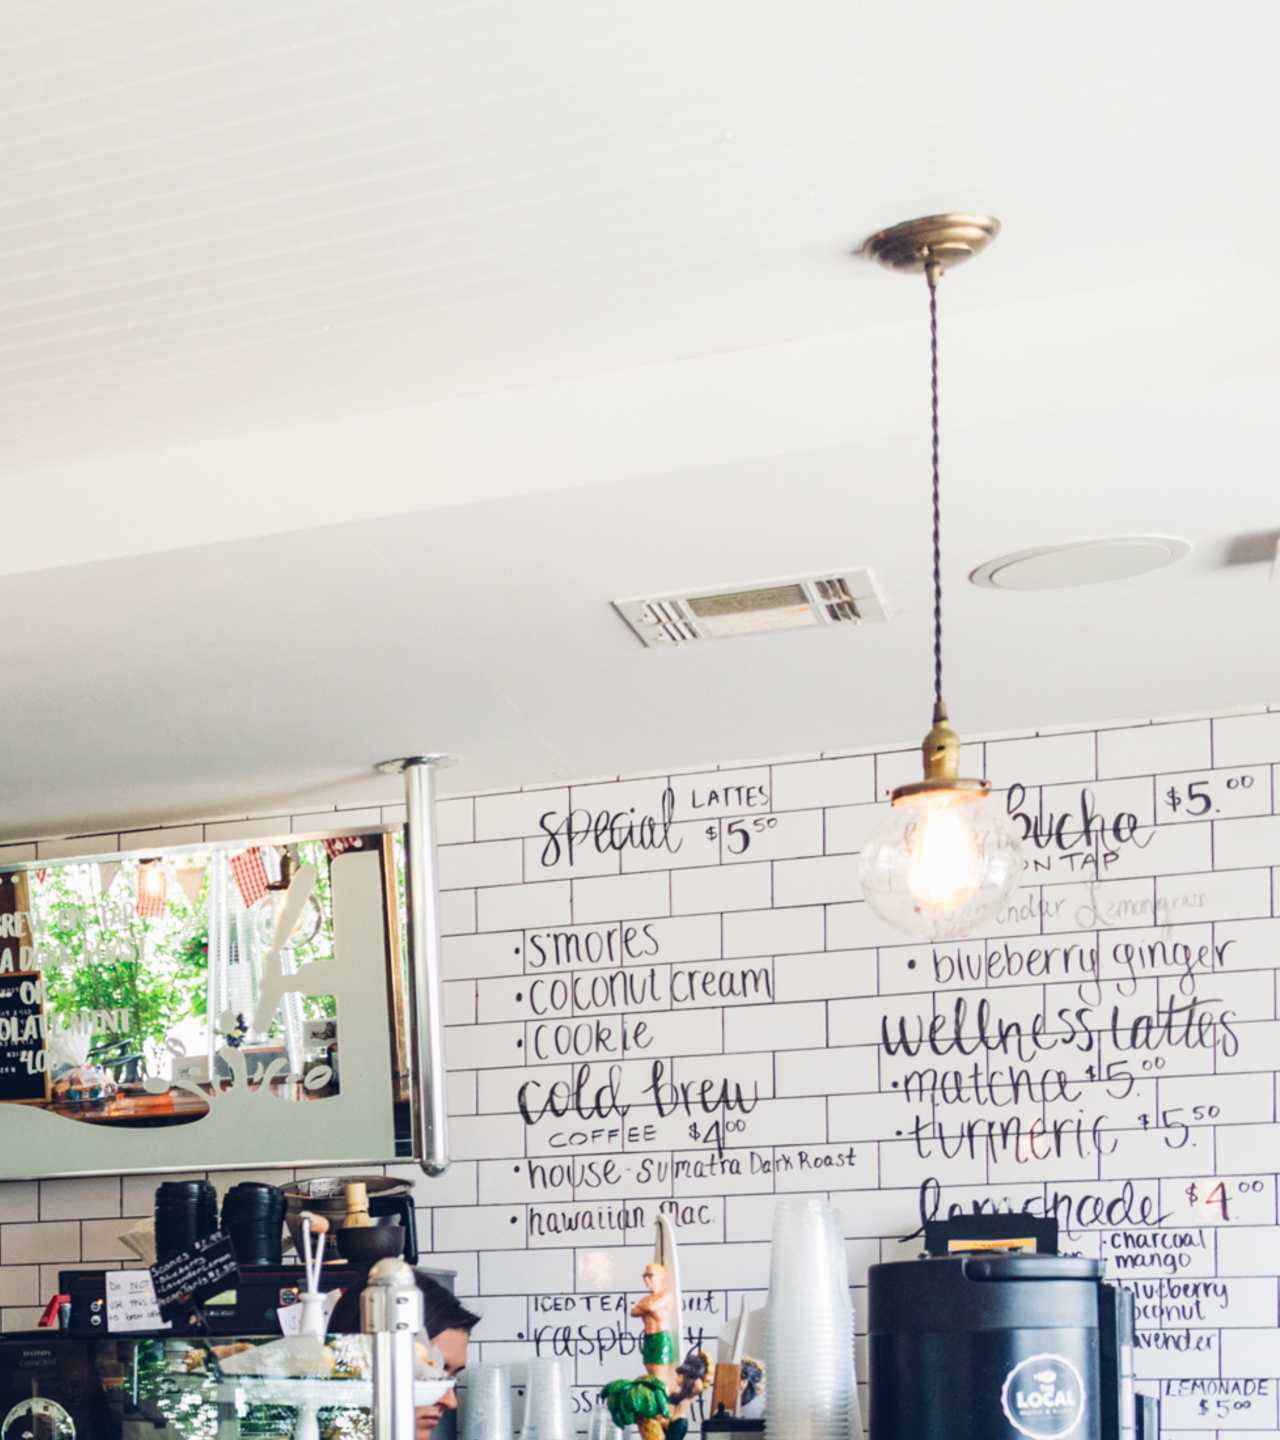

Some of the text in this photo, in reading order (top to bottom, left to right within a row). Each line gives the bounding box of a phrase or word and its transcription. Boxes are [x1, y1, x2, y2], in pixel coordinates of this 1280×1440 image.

[692, 786, 770, 808] LATTES
[539, 787, 683, 866] special
[1059, 851, 1120, 873] TAP
[933, 939, 1236, 1006] blueberry ginger
[529, 968, 772, 1015] coconut cream
[534, 1018, 653, 1060] cookie
[881, 994, 1240, 1062] wellness lattes
[517, 1060, 758, 1125] cold brew
[903, 1061, 1082, 1108] matcha
[548, 1125, 656, 1148] COFFEE
[908, 1109, 1118, 1164] turmeric
[528, 1158, 622, 1189] house
[798, 1147, 858, 1171] Roast
[529, 1204, 646, 1236] hawaiian
[1111, 1229, 1207, 1249] charcoal
[1114, 1251, 1192, 1275] mango
[534, 1295, 577, 1312] ICED
[1132, 1302, 1207, 1322] oconut
[534, 1320, 704, 1367] raspby
[1134, 1330, 1216, 1352] vender
[1016, 1390, 1075, 1409] LOCAL
[1166, 1379, 1269, 1396] LEMONADE
